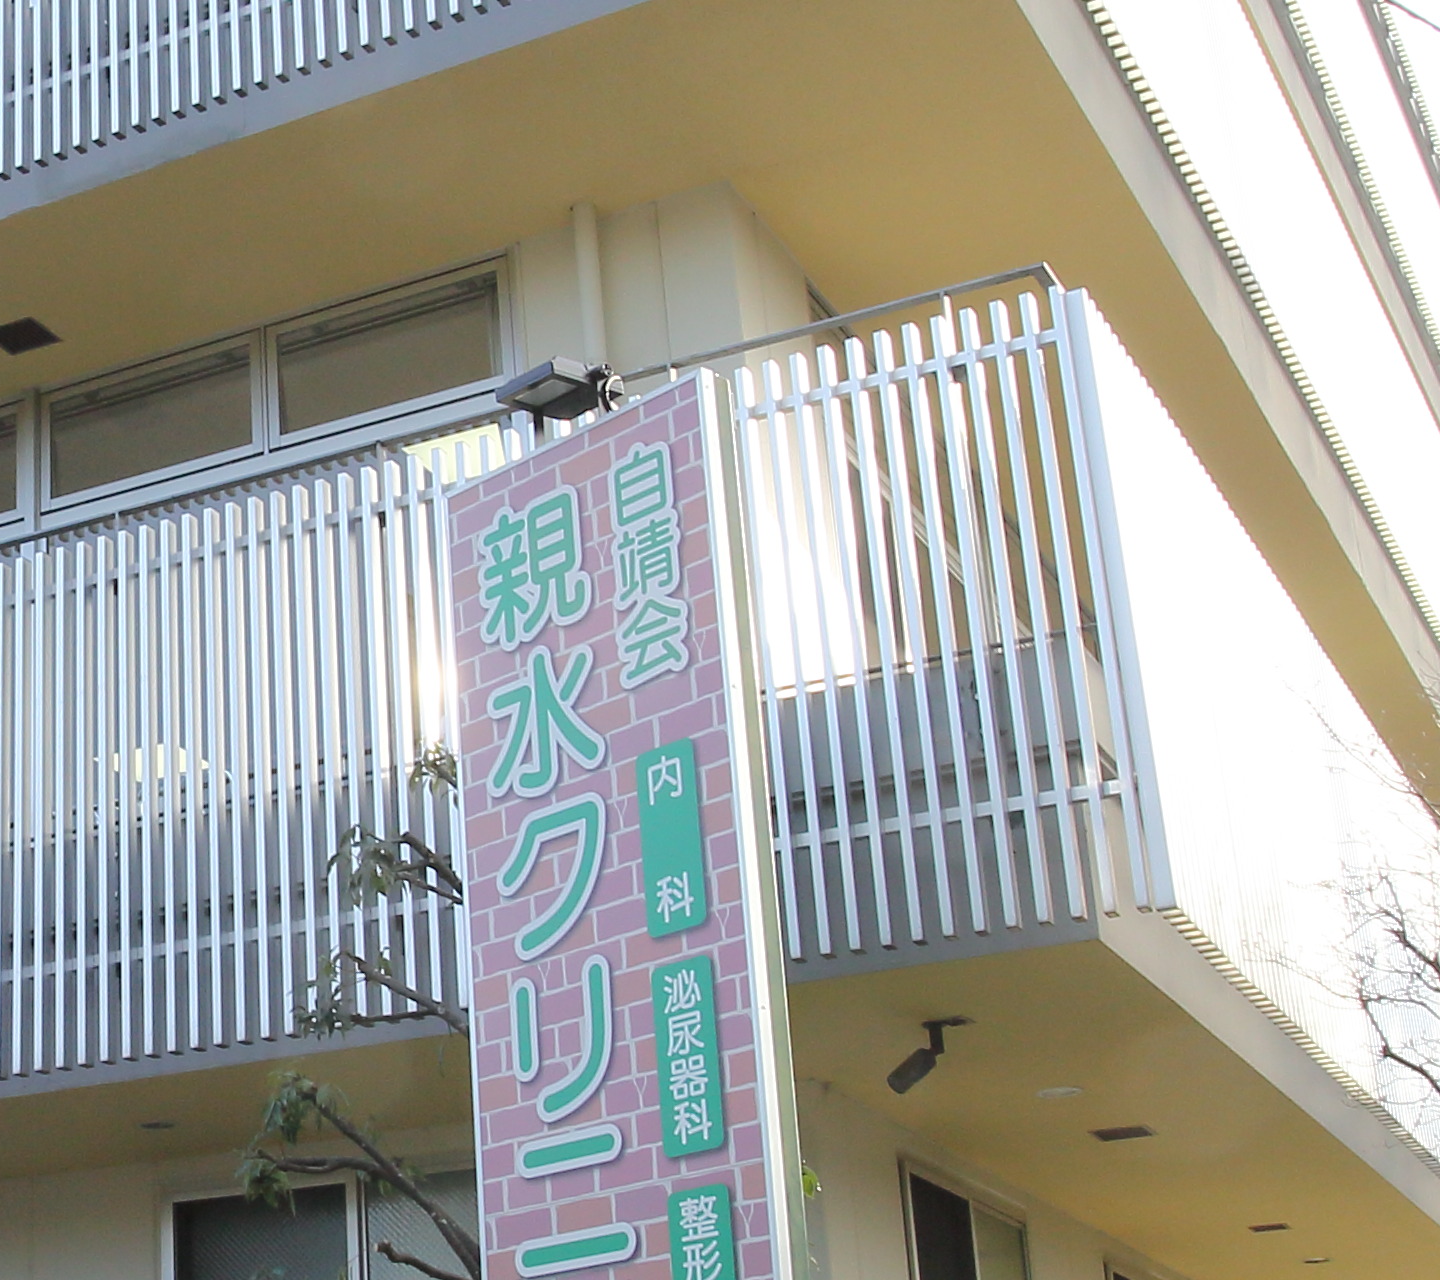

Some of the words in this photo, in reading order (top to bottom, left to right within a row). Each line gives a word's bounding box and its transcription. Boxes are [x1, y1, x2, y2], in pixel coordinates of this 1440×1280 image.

[609, 441, 689, 690] 自靖会
[662, 967, 713, 1146] 泌尿器科
